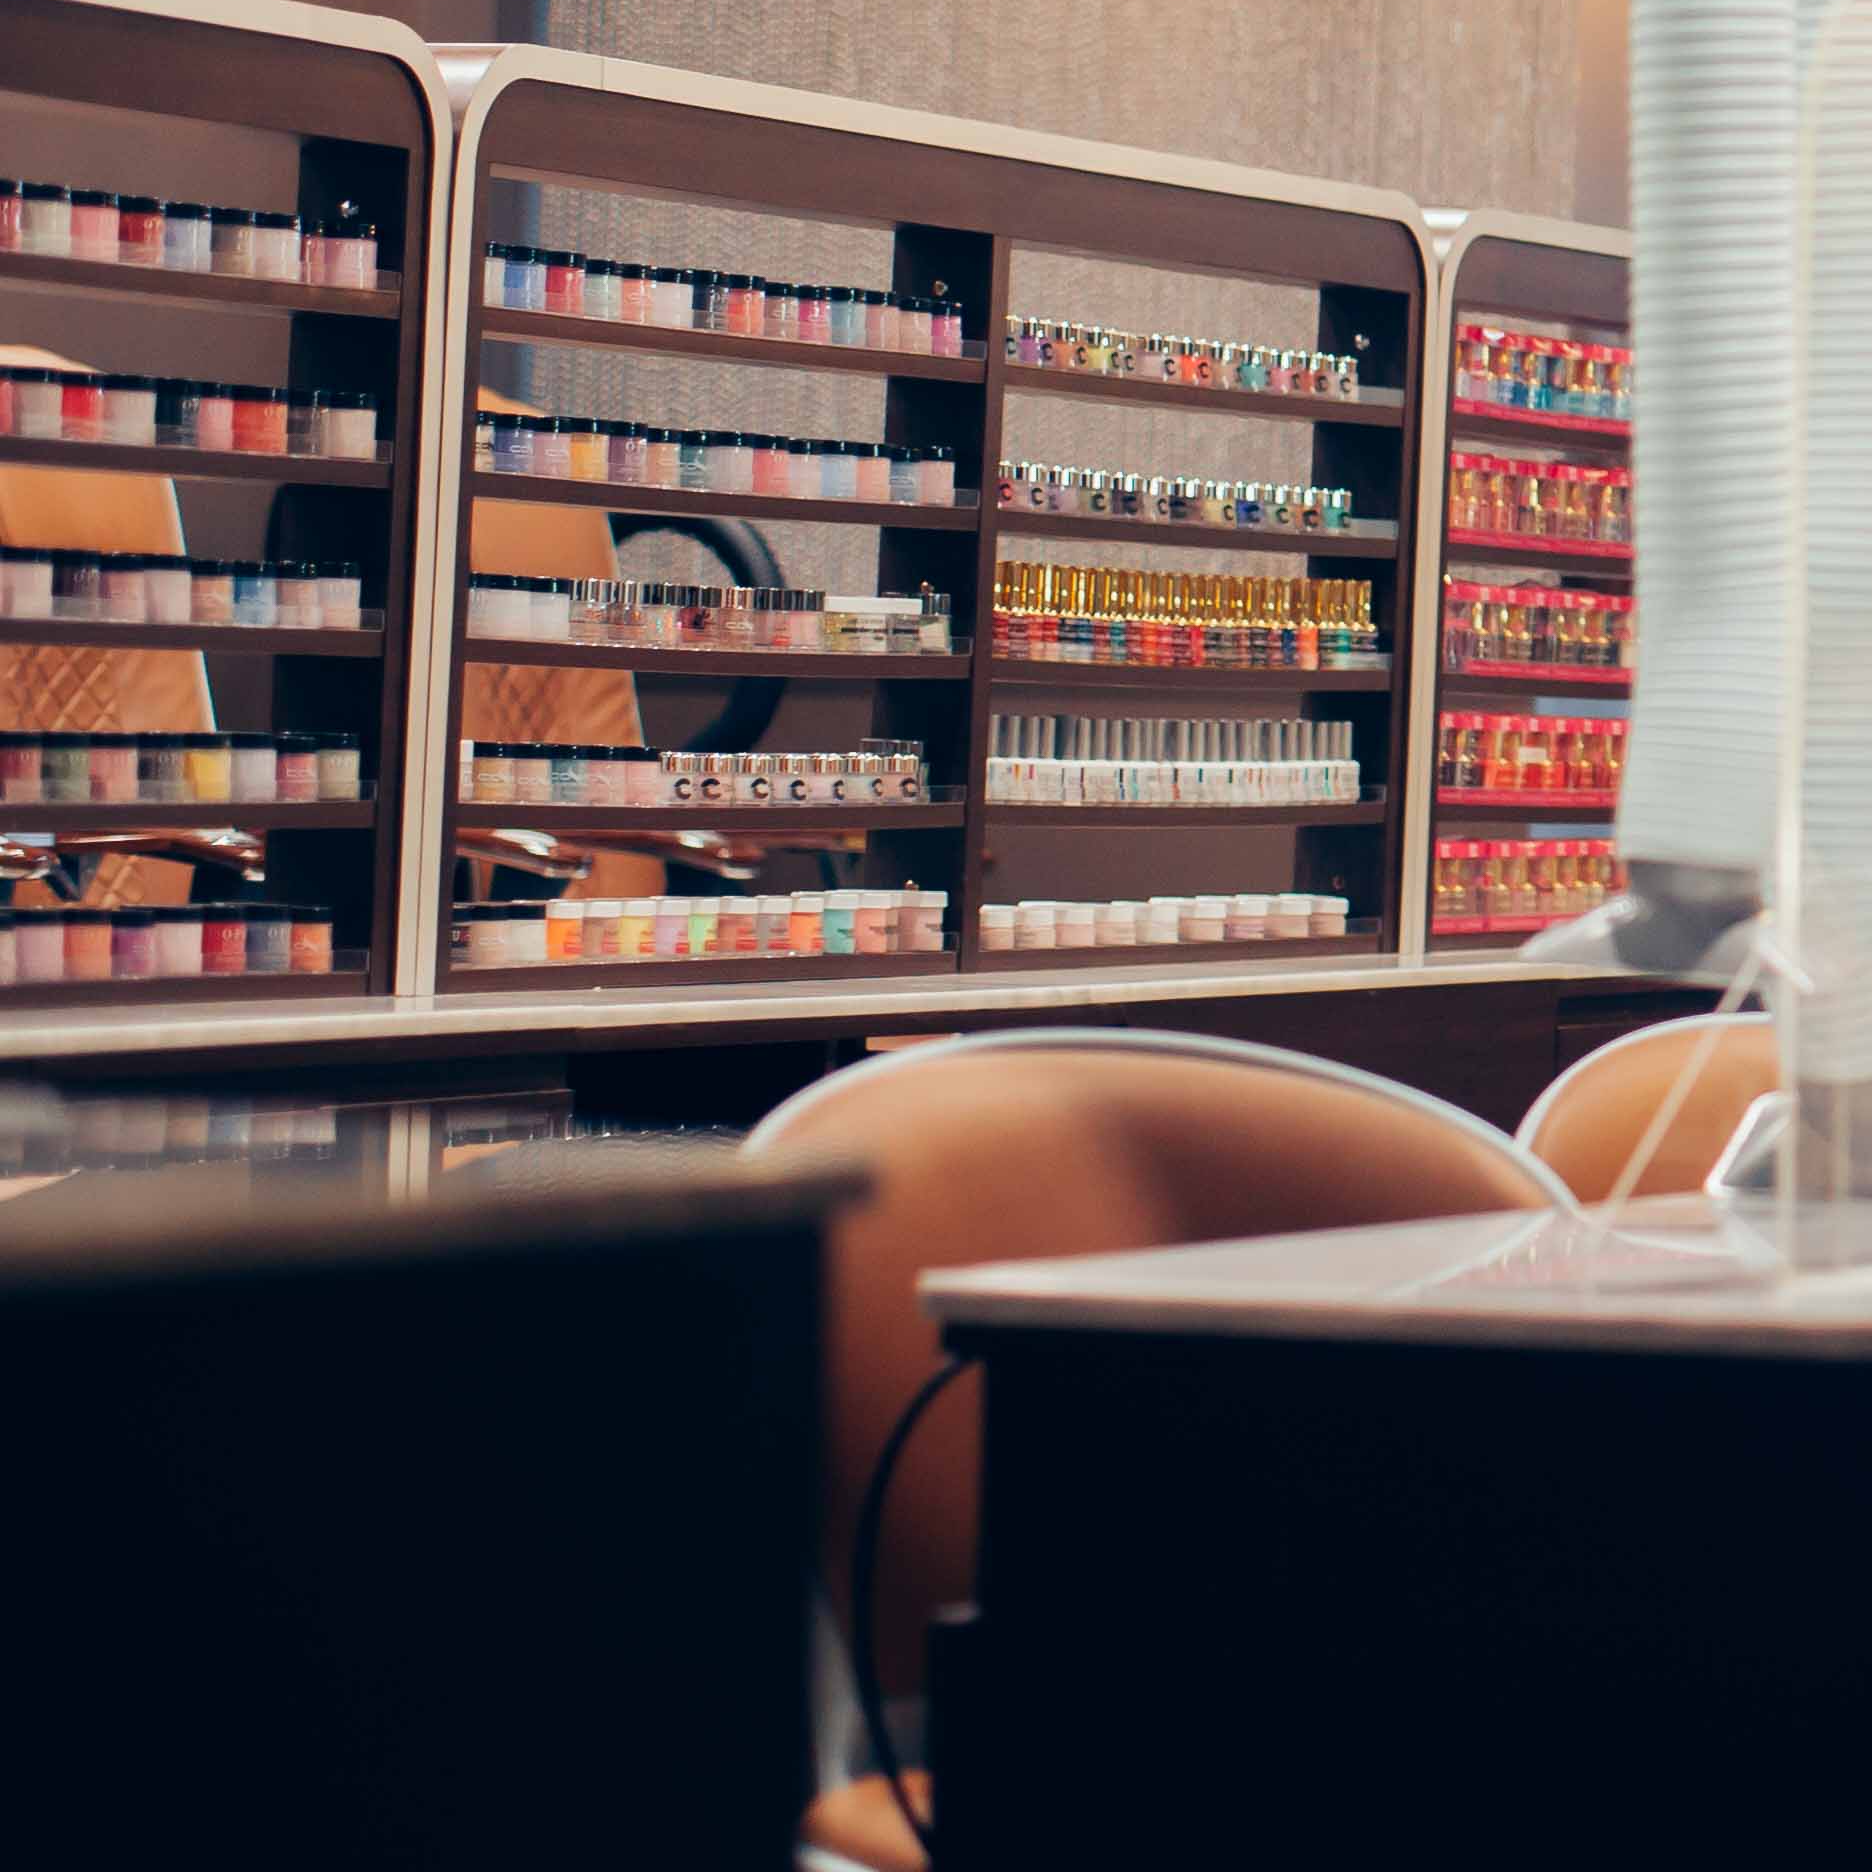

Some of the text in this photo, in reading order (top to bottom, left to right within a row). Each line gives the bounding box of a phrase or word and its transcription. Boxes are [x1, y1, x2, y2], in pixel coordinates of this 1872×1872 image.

[674, 777, 692, 800] C
[701, 777, 721, 800] C
[751, 777, 769, 800] C
[790, 779, 806, 801] C
